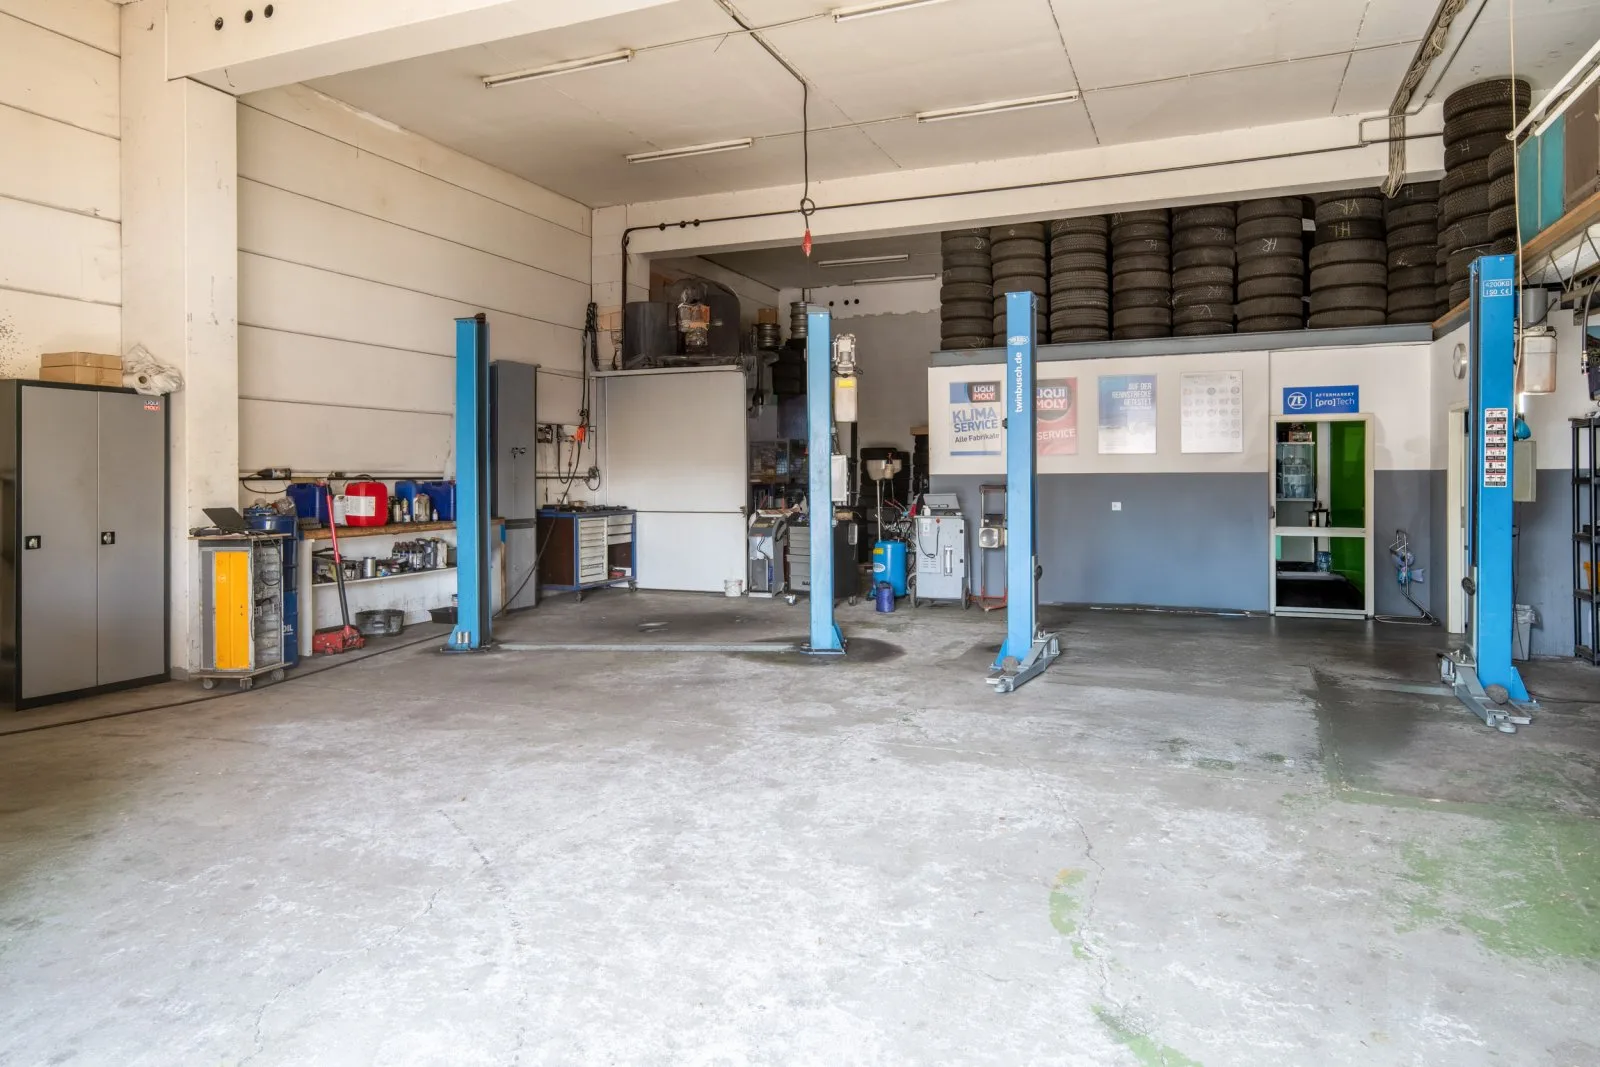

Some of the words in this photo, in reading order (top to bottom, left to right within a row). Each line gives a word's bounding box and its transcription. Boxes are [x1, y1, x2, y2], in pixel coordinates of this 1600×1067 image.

[973, 385, 995, 393] LIQUI
[1014, 352, 1023, 413] twinbusch.de
[973, 392, 996, 401] MOLY
[952, 406, 998, 423] KLIMA
[954, 418, 998, 433] SERVICE
